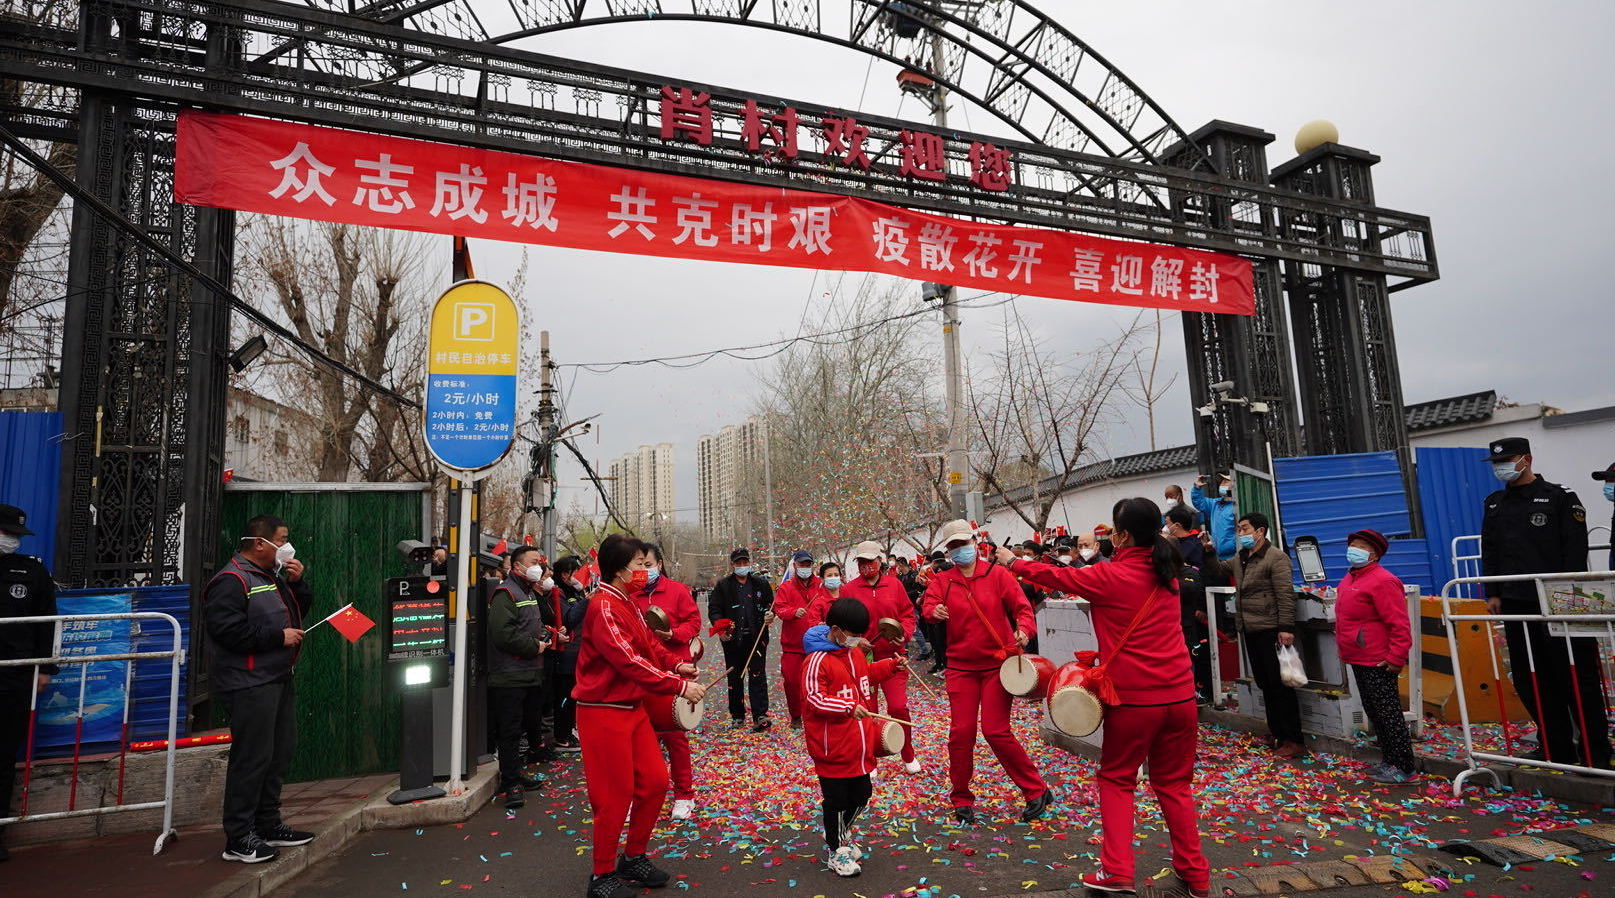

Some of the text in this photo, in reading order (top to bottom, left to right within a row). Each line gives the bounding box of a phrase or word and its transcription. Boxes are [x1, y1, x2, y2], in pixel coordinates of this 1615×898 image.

[660, 86, 1014, 192] 肖村欢迎您
[268, 141, 1220, 304] 众志成城 共克时艰 疫散花开 喜迎解封
[461, 308, 488, 335] P
[435, 352, 512, 365] 村民自治停车
[444, 392, 500, 406] 2元/小时
